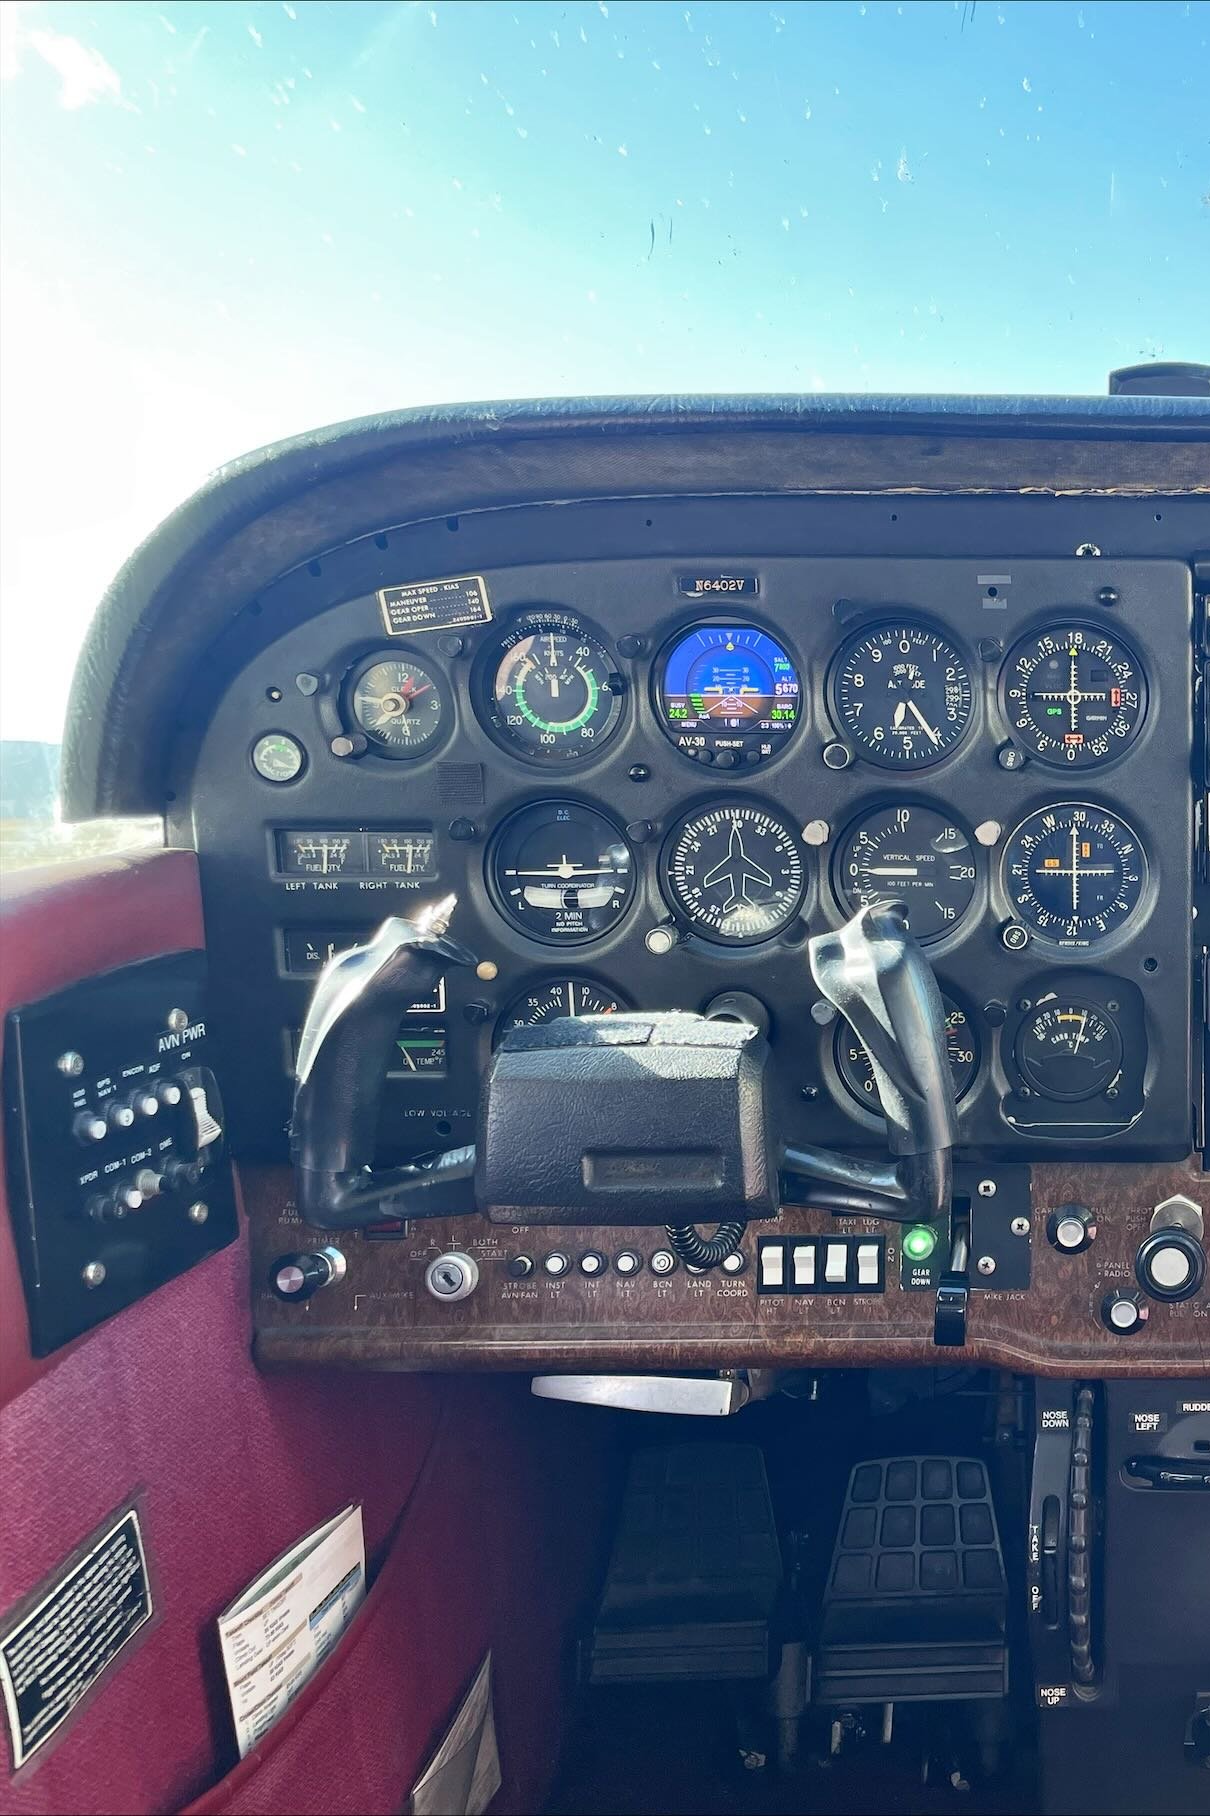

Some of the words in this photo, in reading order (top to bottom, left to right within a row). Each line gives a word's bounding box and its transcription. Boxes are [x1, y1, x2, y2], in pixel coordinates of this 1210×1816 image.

[418, 585, 439, 595] SPEED
[444, 583, 459, 591] KIAS
[696, 580, 745, 591] N6402V
[390, 597, 427, 607] MANEUVER
[391, 607, 409, 616] GEAR
[411, 604, 429, 612] OPER
[393, 615, 411, 624] GEAR
[412, 613, 436, 621] DOWN
[1068, 632, 1083, 644] 18
[899, 639, 910, 654] 0
[1037, 637, 1054, 652] 15
[1097, 640, 1113, 655] 21
[576, 646, 590, 657] 40
[871, 649, 882, 663] 9
[946, 668, 956, 681] 2
[1117, 663, 1133, 679] 24
[398, 672, 409, 683] 12
[853, 674, 865, 688] 8
[775, 683, 799, 695] 5670
[669, 709, 688, 719] 24.2
[771, 710, 795, 720] 30.14
[853, 703, 864, 717] 7
[947, 708, 957, 721] 3
[1047, 708, 1062, 716] GPS
[507, 715, 523, 725] 120
[581, 728, 594, 738] 80
[874, 727, 884, 741] 6
[540, 734, 556, 744] 100
[679, 737, 705, 747] AV-30
[903, 736, 913, 750] 5
[897, 809, 910, 822] 10
[1073, 811, 1086, 822] 30
[1042, 815, 1056, 828] W
[1101, 820, 1115, 833] 33
[860, 832, 868, 844] 5
[944, 828, 956, 840] 15
[1122, 843, 1134, 855] N
[960, 867, 975, 878] 20
[285, 882, 305, 890] LEFT
[312, 882, 339, 890] TANK
[359, 881, 387, 889] RIGHT
[395, 881, 421, 889] TANK
[555, 912, 562, 920] 2
[564, 912, 583, 920] MIN
[943, 907, 955, 919] 15
[550, 986, 562, 996] 40
[582, 986, 590, 996] 10
[527, 998, 539, 1007] 35
[951, 1012, 966, 1024] 25
[158, 1033, 180, 1053] AVN
[182, 1023, 206, 1044] PWR
[957, 1051, 973, 1063] 30
[104, 1159, 127, 1174] COM-1
[131, 1148, 152, 1164] COM-2
[472, 1238, 498, 1246] BOTH
[1104, 1262, 1130, 1270] PANEL
[912, 1269, 930, 1278] GEAR
[1104, 1270, 1130, 1278] RADIO
[503, 1282, 537, 1290] STROBE
[616, 1281, 636, 1289] NAV
[653, 1280, 673, 1289] BCN
[687, 1280, 712, 1289] LAND
[721, 1280, 745, 1288] TURN
[911, 1277, 931, 1286] DOWN
[501, 1292, 518, 1300] AVN
[520, 1292, 539, 1300] FAN
[716, 1289, 748, 1298] COORD
[983, 1293, 1003, 1301] MIKE
[1005, 1293, 1026, 1301] JACK
[759, 1299, 785, 1307] PITOT
[795, 1299, 814, 1307] NAV
[827, 1299, 846, 1307] BCN
[1042, 1411, 1068, 1420] NOSE
[1134, 1414, 1160, 1423] NOSE
[1042, 1419, 1069, 1428] DOWN
[1136, 1422, 1158, 1431] LEFT
[1031, 1525, 1039, 1561] TAKE
[1031, 1586, 1040, 1611] OFF
[1040, 1688, 1066, 1697] NOSE
[1047, 1696, 1060, 1705] UP
